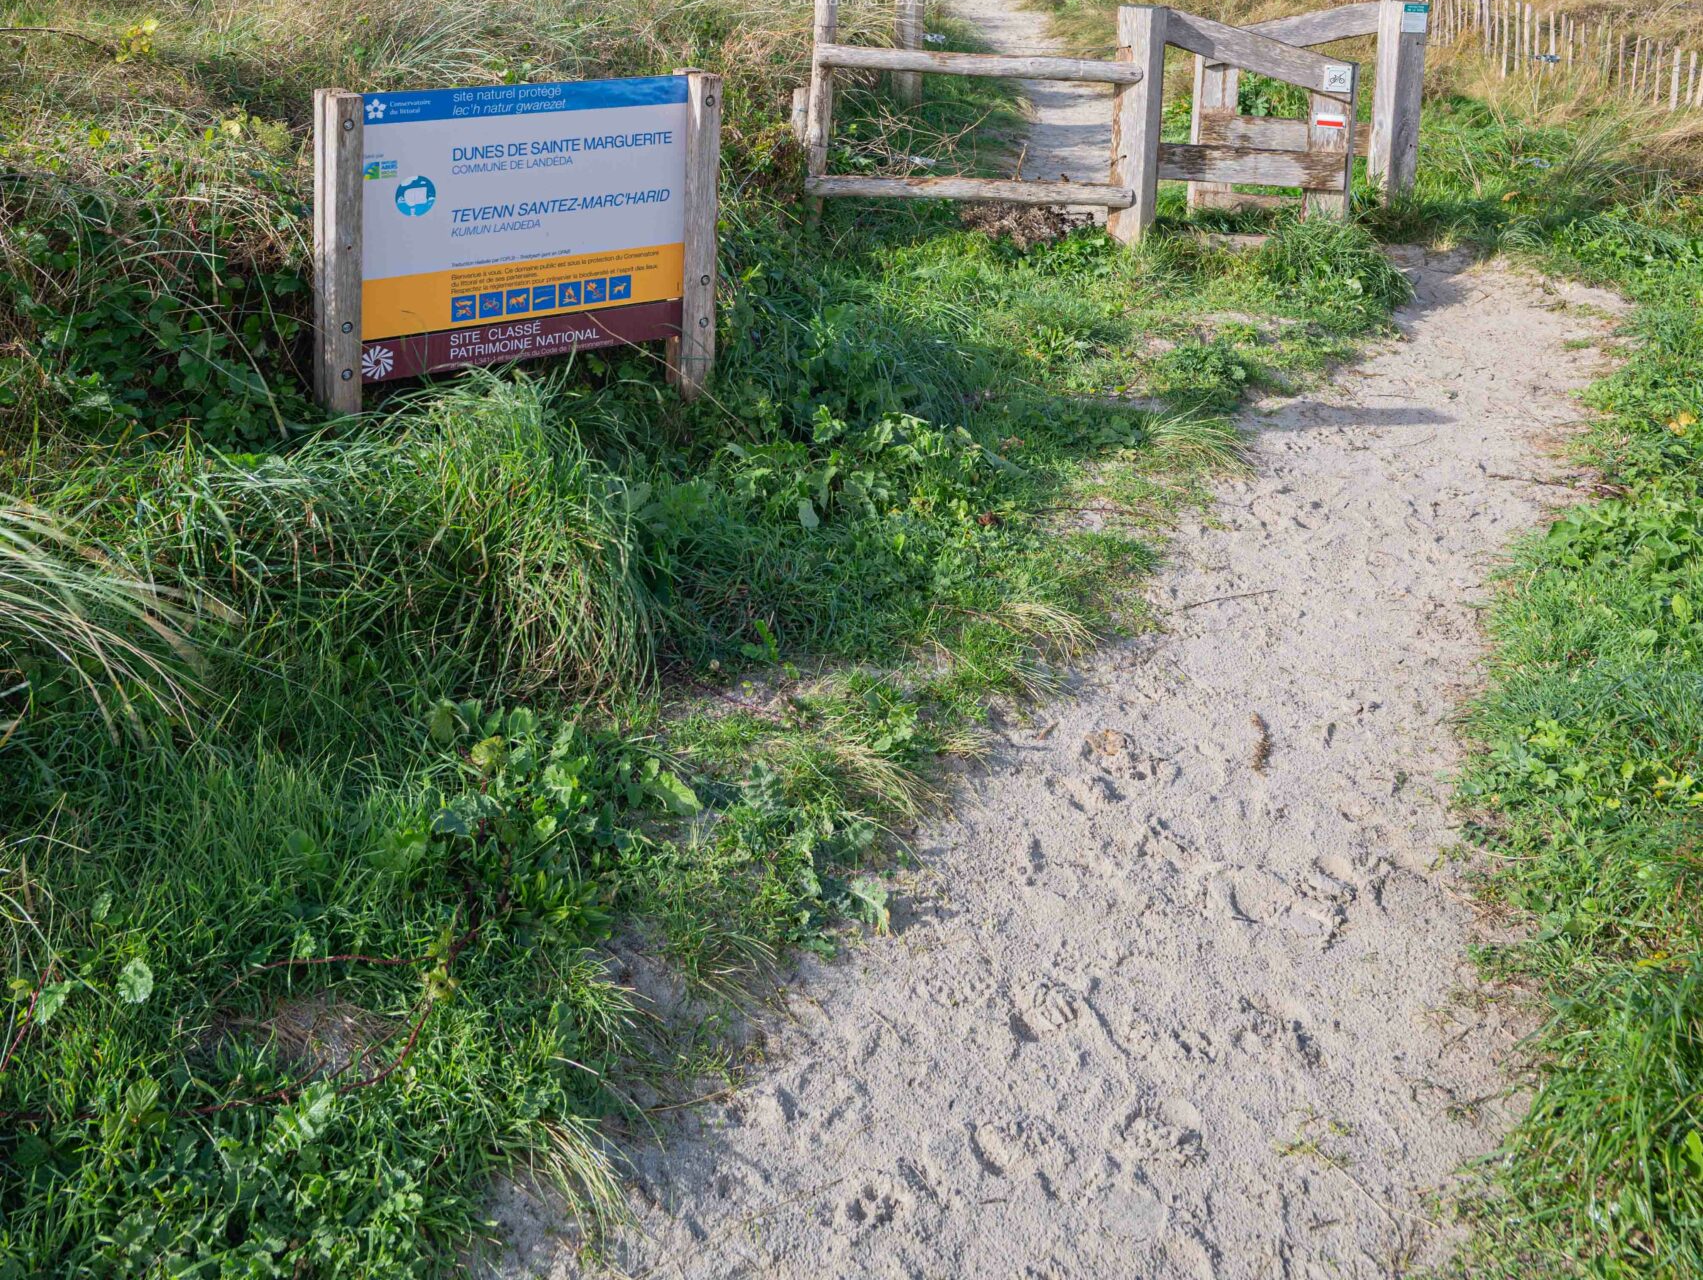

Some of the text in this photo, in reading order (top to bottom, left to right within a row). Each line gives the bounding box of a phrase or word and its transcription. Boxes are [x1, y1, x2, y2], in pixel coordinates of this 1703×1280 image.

[453, 85, 562, 102] site naturel protégé
[389, 99, 431, 107] Conservatoire
[453, 99, 566, 116] lec'h natur gwarezet
[452, 131, 672, 161] DUNES DE SAINTE MARGUERITE
[451, 160, 507, 175] COMMUNE
[510, 159, 525, 170] DE
[451, 188, 670, 223] TEVENN SANTEZ-MARC'HARID
[451, 219, 541, 237] KUMUN LANDEDA
[540, 262, 556, 270] public
[588, 255, 614, 264] protection
[450, 320, 542, 346] SITE CLASSÉ
[450, 328, 600, 359] PATRIMOINE NATIONAL
